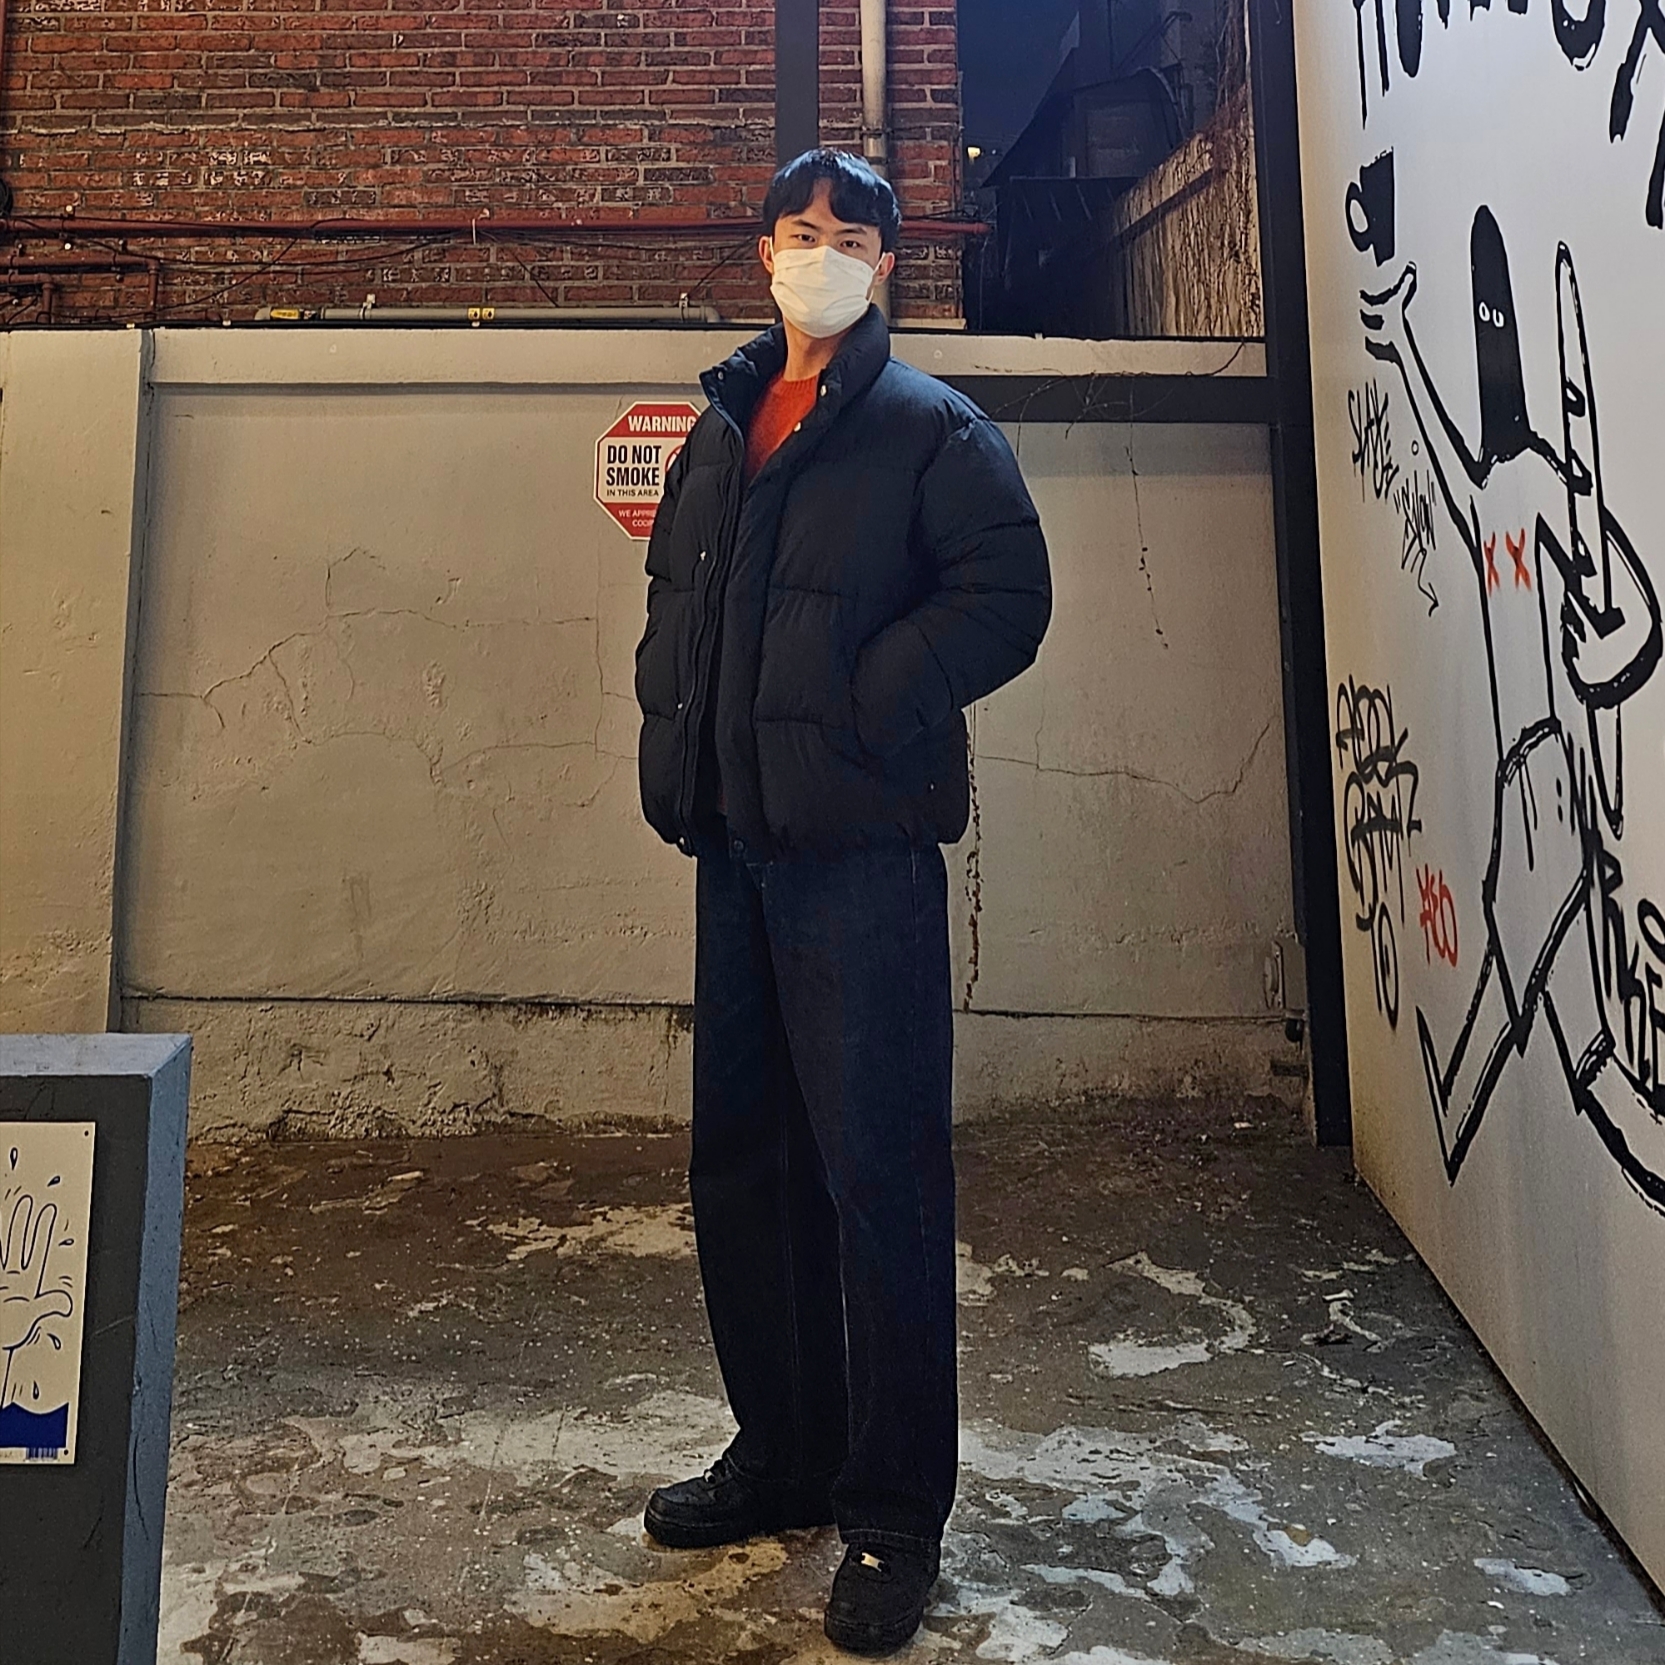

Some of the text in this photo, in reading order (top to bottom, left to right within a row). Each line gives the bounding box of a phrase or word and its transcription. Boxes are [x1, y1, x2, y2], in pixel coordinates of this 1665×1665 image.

[607, 445, 662, 464] DO NOT
[606, 467, 660, 486] SMOKE
[607, 489, 659, 497] IN THIS AREA
[618, 509, 631, 518] WE
